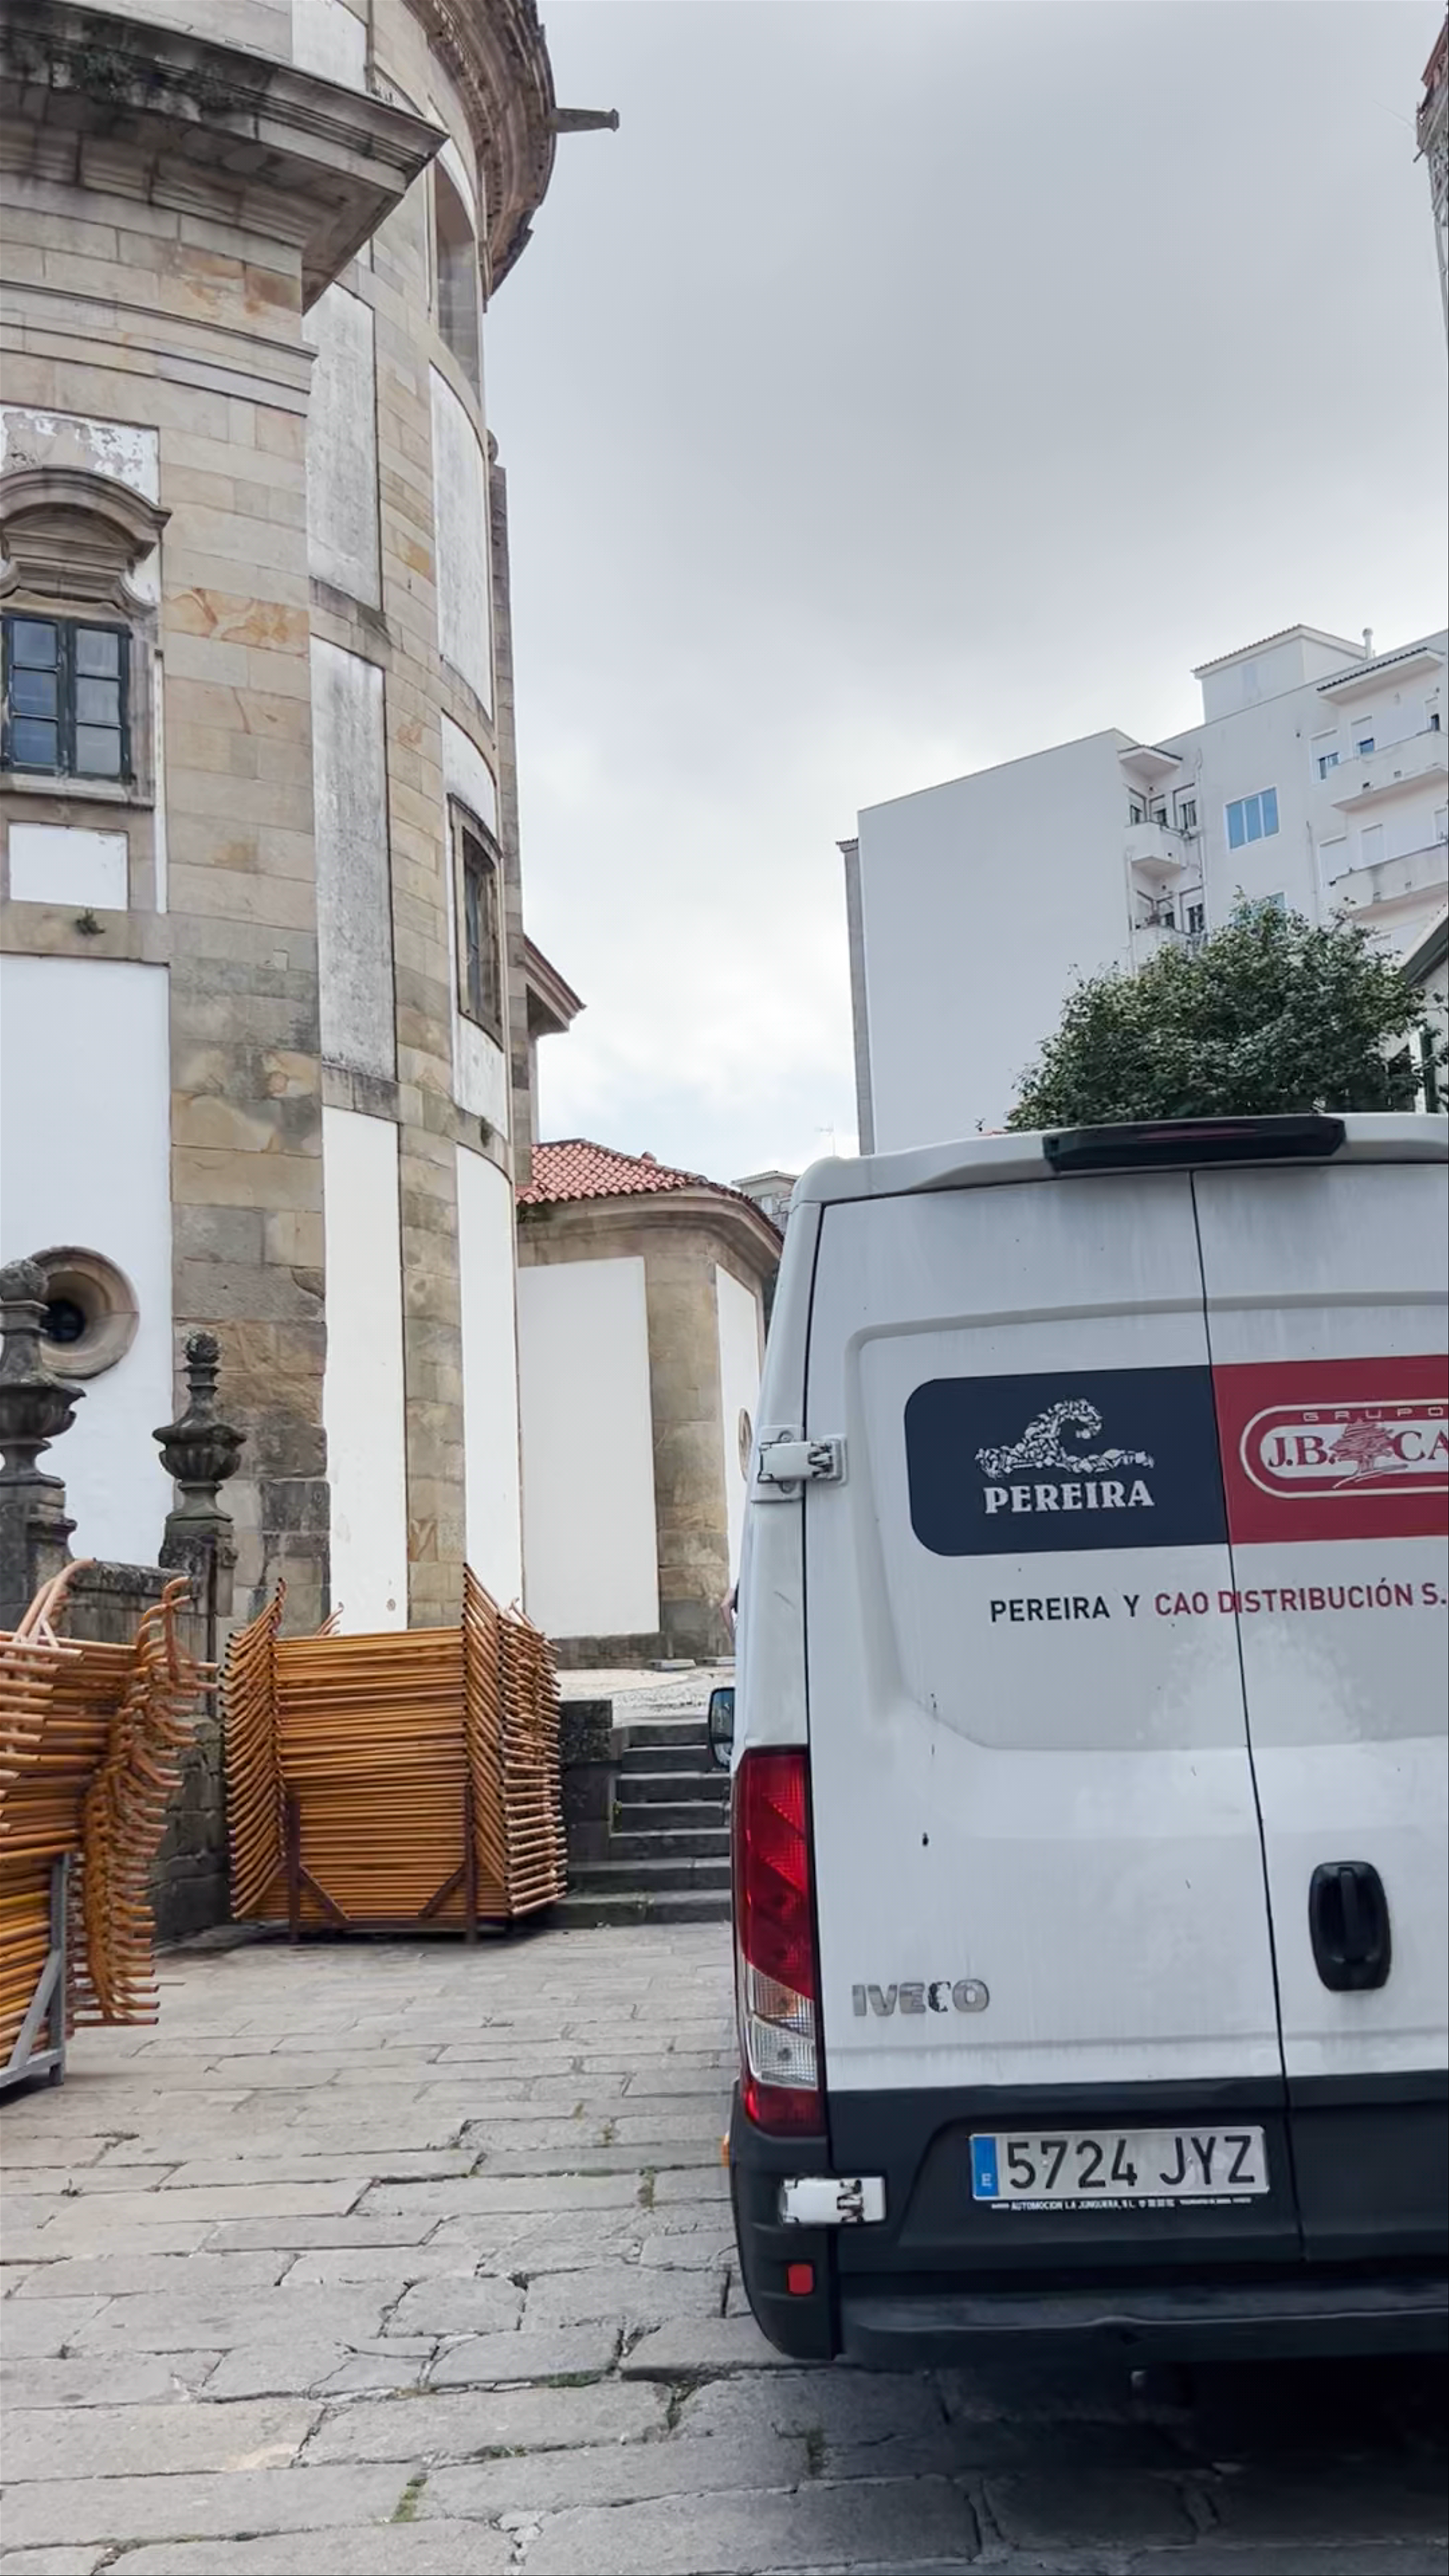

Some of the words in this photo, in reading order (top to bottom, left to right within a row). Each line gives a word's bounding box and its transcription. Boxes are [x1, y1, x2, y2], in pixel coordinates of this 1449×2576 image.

[1303, 1407, 1444, 1421] GRUPO
[1268, 1435, 1336, 1467] J.B.
[983, 1480, 1155, 1514] PEREIRA
[991, 1596, 1110, 1622] PEREIRA
[1123, 1595, 1140, 1617] Y
[1155, 1592, 1209, 1615] CAO
[1218, 1577, 1413, 1613] DISTRIBUCIÓN
[852, 1979, 990, 2016] IVECO
[1007, 2139, 1137, 2189] 5724
[1160, 2135, 1255, 2185] JYZ
[981, 2173, 992, 2187] E
